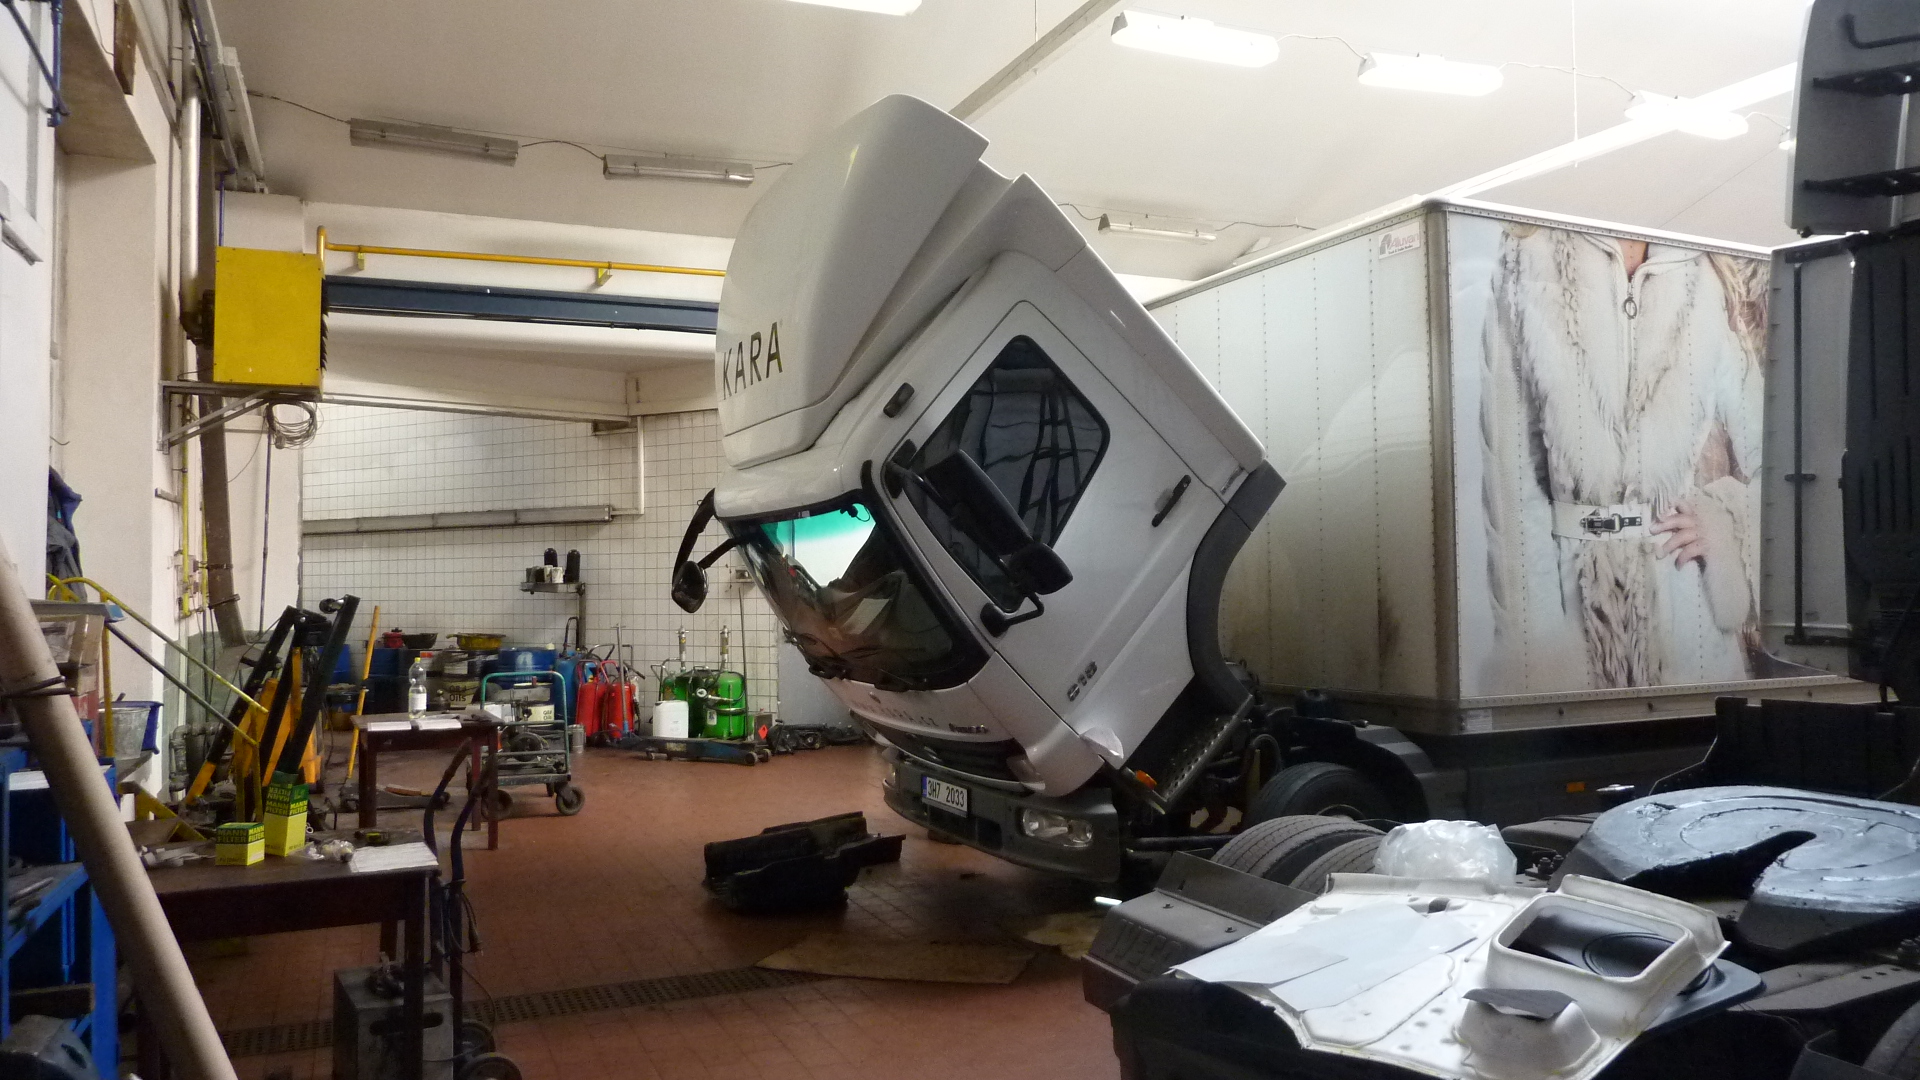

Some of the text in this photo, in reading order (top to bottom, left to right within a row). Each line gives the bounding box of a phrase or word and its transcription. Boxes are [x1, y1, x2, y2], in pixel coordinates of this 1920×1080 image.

[723, 321, 783, 400] KARA
[927, 780, 965, 808] 3H7 2033
[266, 800, 289, 810] MANN
[290, 799, 308, 809] MANN
[265, 806, 288, 816] FILTER
[289, 805, 308, 817] FILTER
[248, 825, 265, 835] MANN
[248, 832, 265, 843] FILTER
